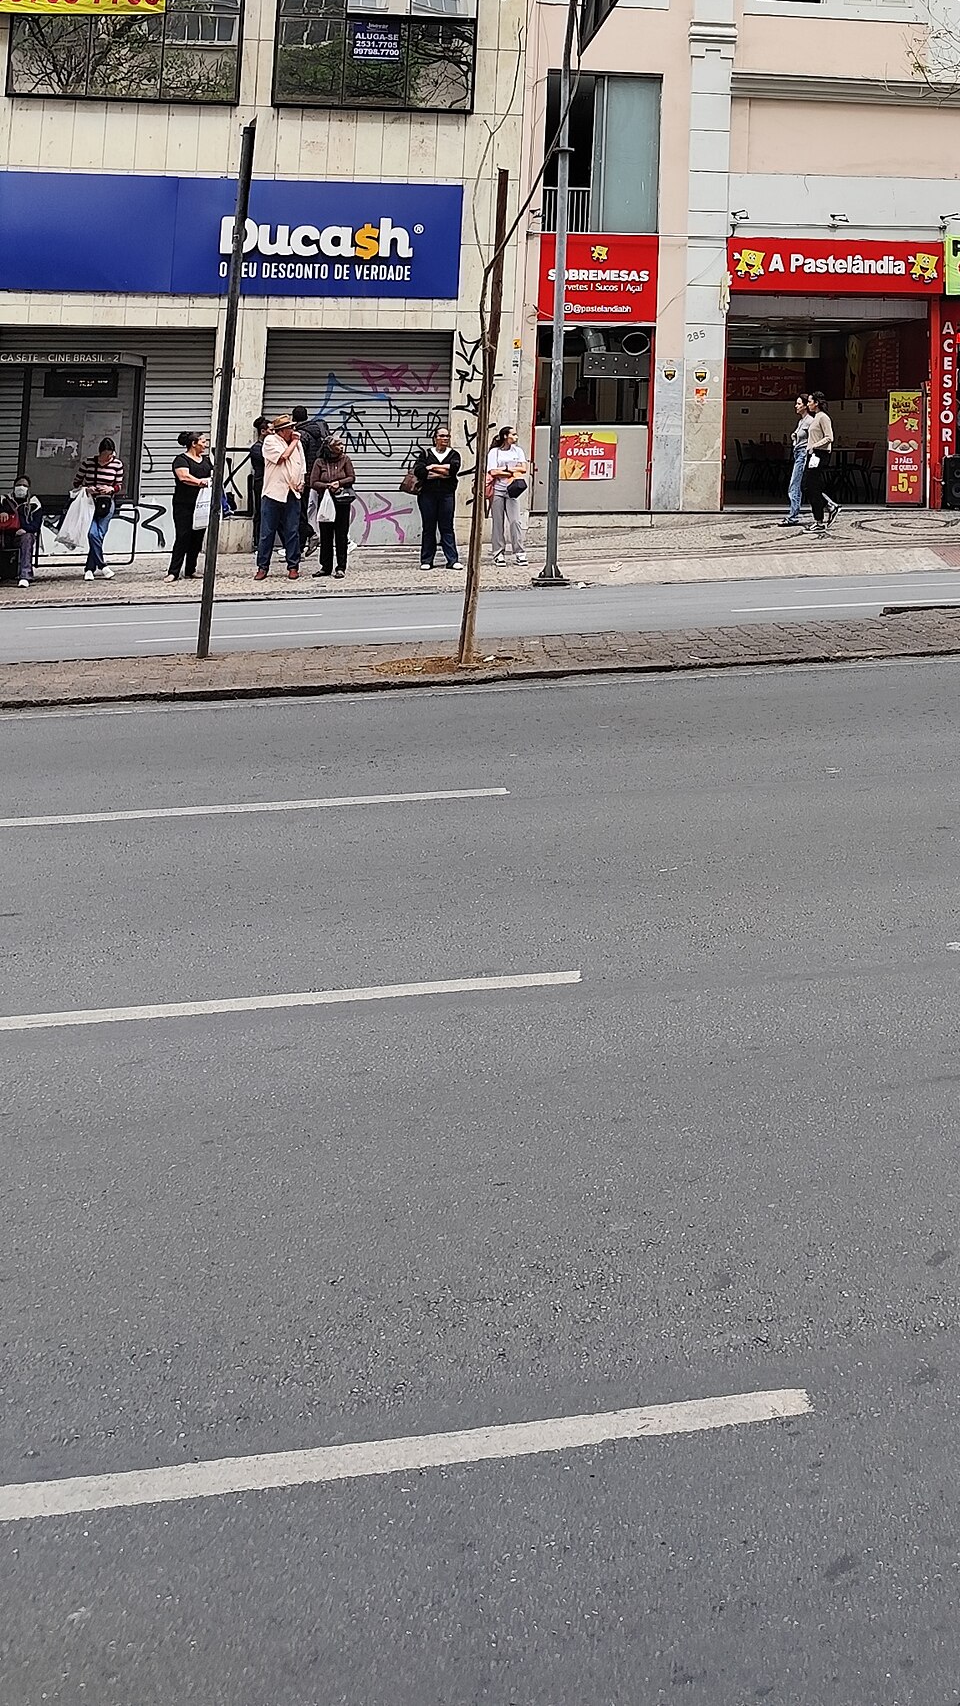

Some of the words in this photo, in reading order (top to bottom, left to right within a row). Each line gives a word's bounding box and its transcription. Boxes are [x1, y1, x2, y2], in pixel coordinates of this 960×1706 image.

[354, 32, 399, 41] ALUGA-SE
[355, 40, 398, 49] 2531.7705
[353, 47, 400, 56] 99798.7700
[768, 253, 785, 273] A
[790, 254, 906, 275] Pastelândia
[219, 260, 228, 278] O
[240, 261, 258, 279] EU
[261, 262, 329, 280] DESCONTO
[334, 264, 351, 281] DE
[355, 264, 412, 281] VERDADE
[595, 283, 618, 292] Sucos
[686, 329, 706, 343] 285
[16, 354, 38, 363] SETE
[47, 354, 71, 363] CINE
[73, 354, 104, 363] BRASIL
[113, 354, 119, 363] 2
[940, 321, 955, 457] ACESSÓRI
[566, 447, 573, 456] 6
